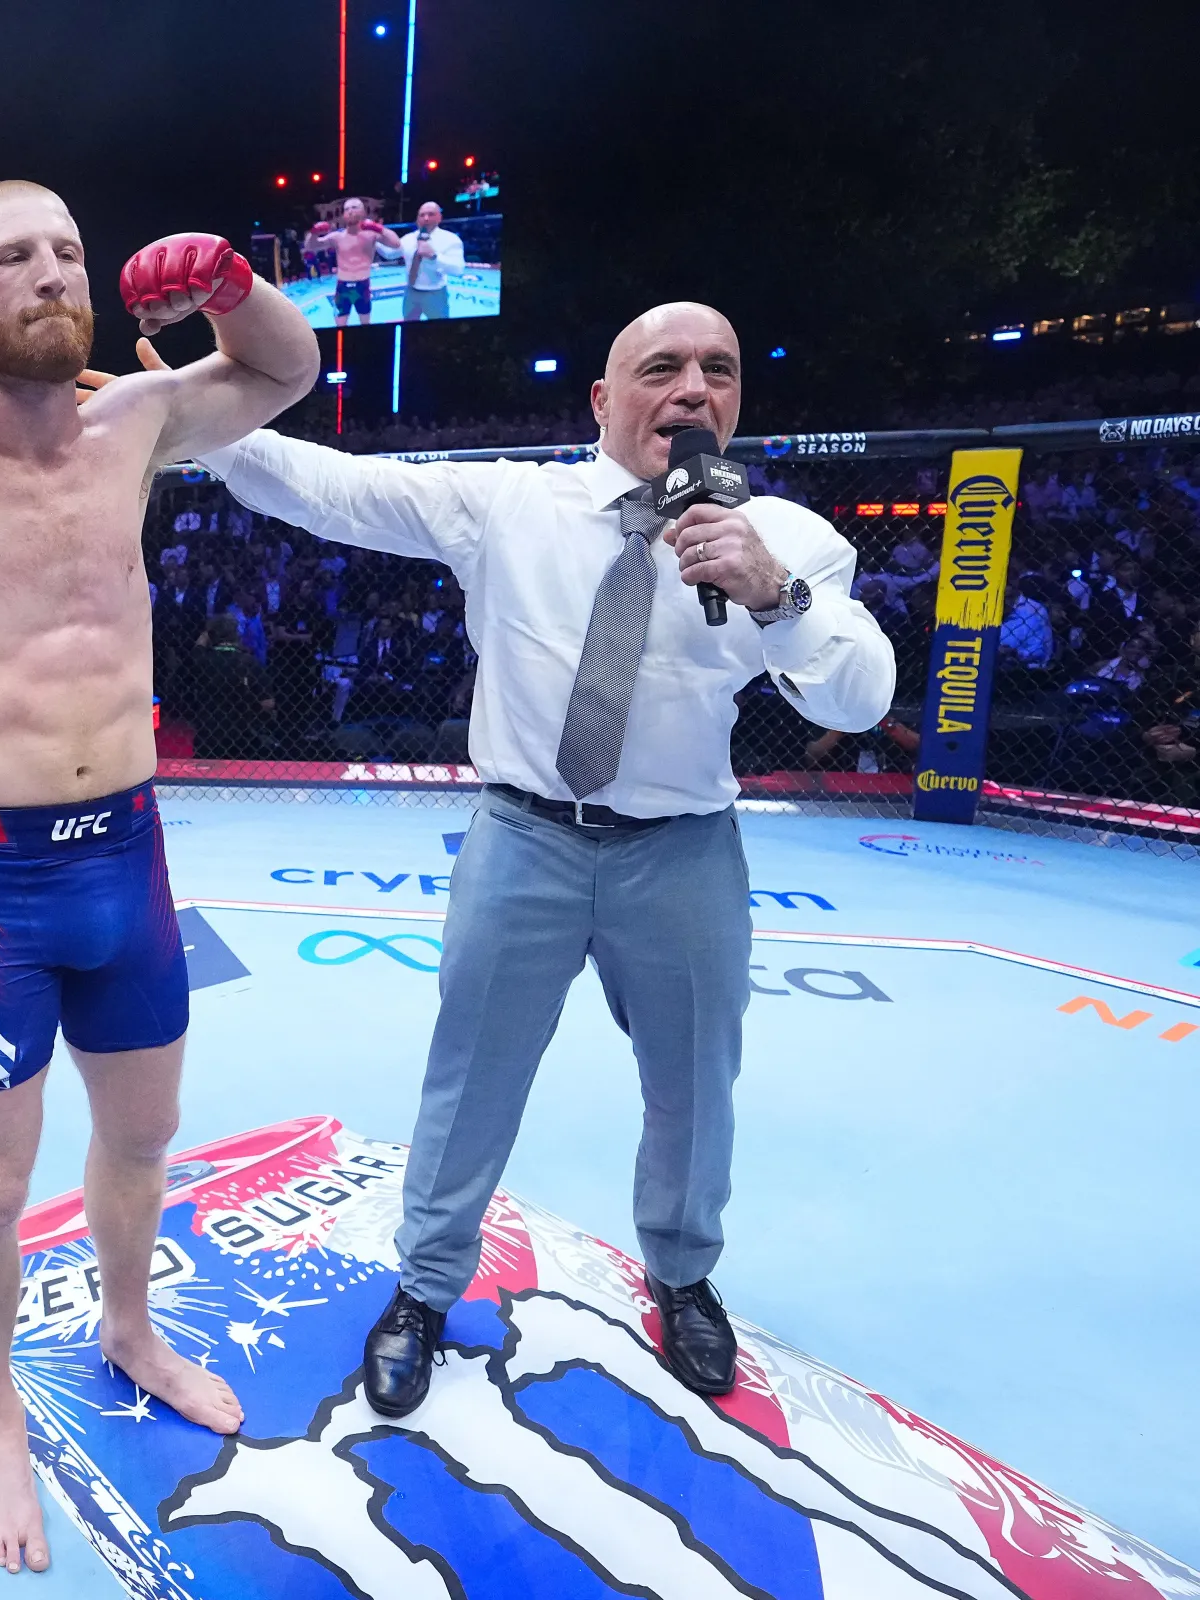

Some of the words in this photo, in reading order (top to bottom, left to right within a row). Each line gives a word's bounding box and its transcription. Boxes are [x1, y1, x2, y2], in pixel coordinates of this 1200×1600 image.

[796, 432, 867, 443] RIYADH
[1130, 419, 1153, 436] NO
[1153, 415, 1194, 435] DAYS
[797, 442, 866, 454] SEASON
[657, 479, 703, 511] Paramount+
[950, 474, 1016, 592] Cuervo
[937, 637, 982, 734] TEQUILA
[917, 768, 979, 792] Cuervo
[50, 811, 112, 842] UFC
[210, 1154, 406, 1249] SUGAR
